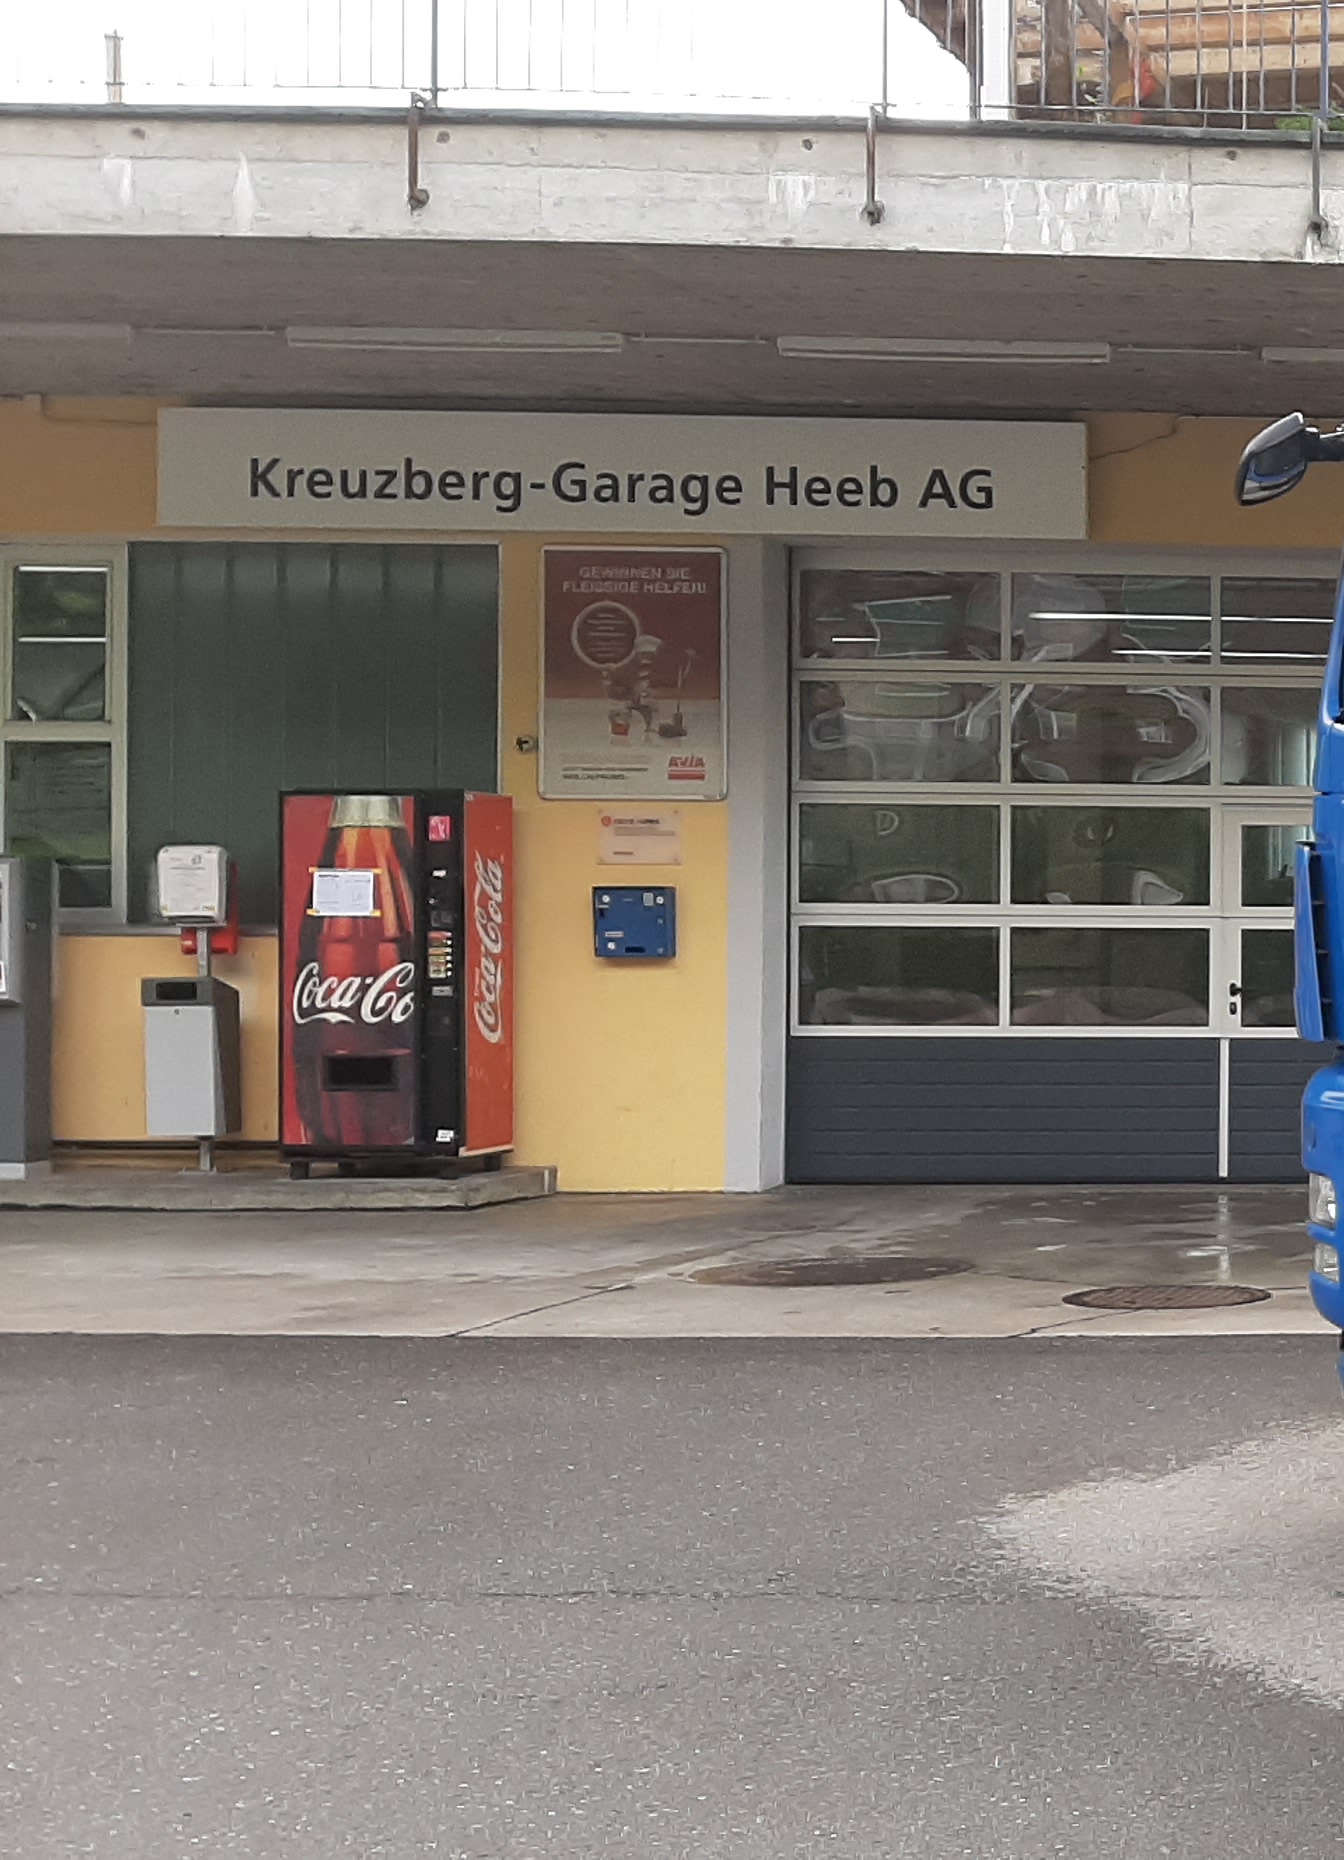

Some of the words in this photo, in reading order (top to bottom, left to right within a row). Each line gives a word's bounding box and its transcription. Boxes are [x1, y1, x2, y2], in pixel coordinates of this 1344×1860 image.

[249, 456, 744, 516] Kreuzberg-Garage
[765, 465, 899, 509] Heeb
[917, 468, 995, 510] AG
